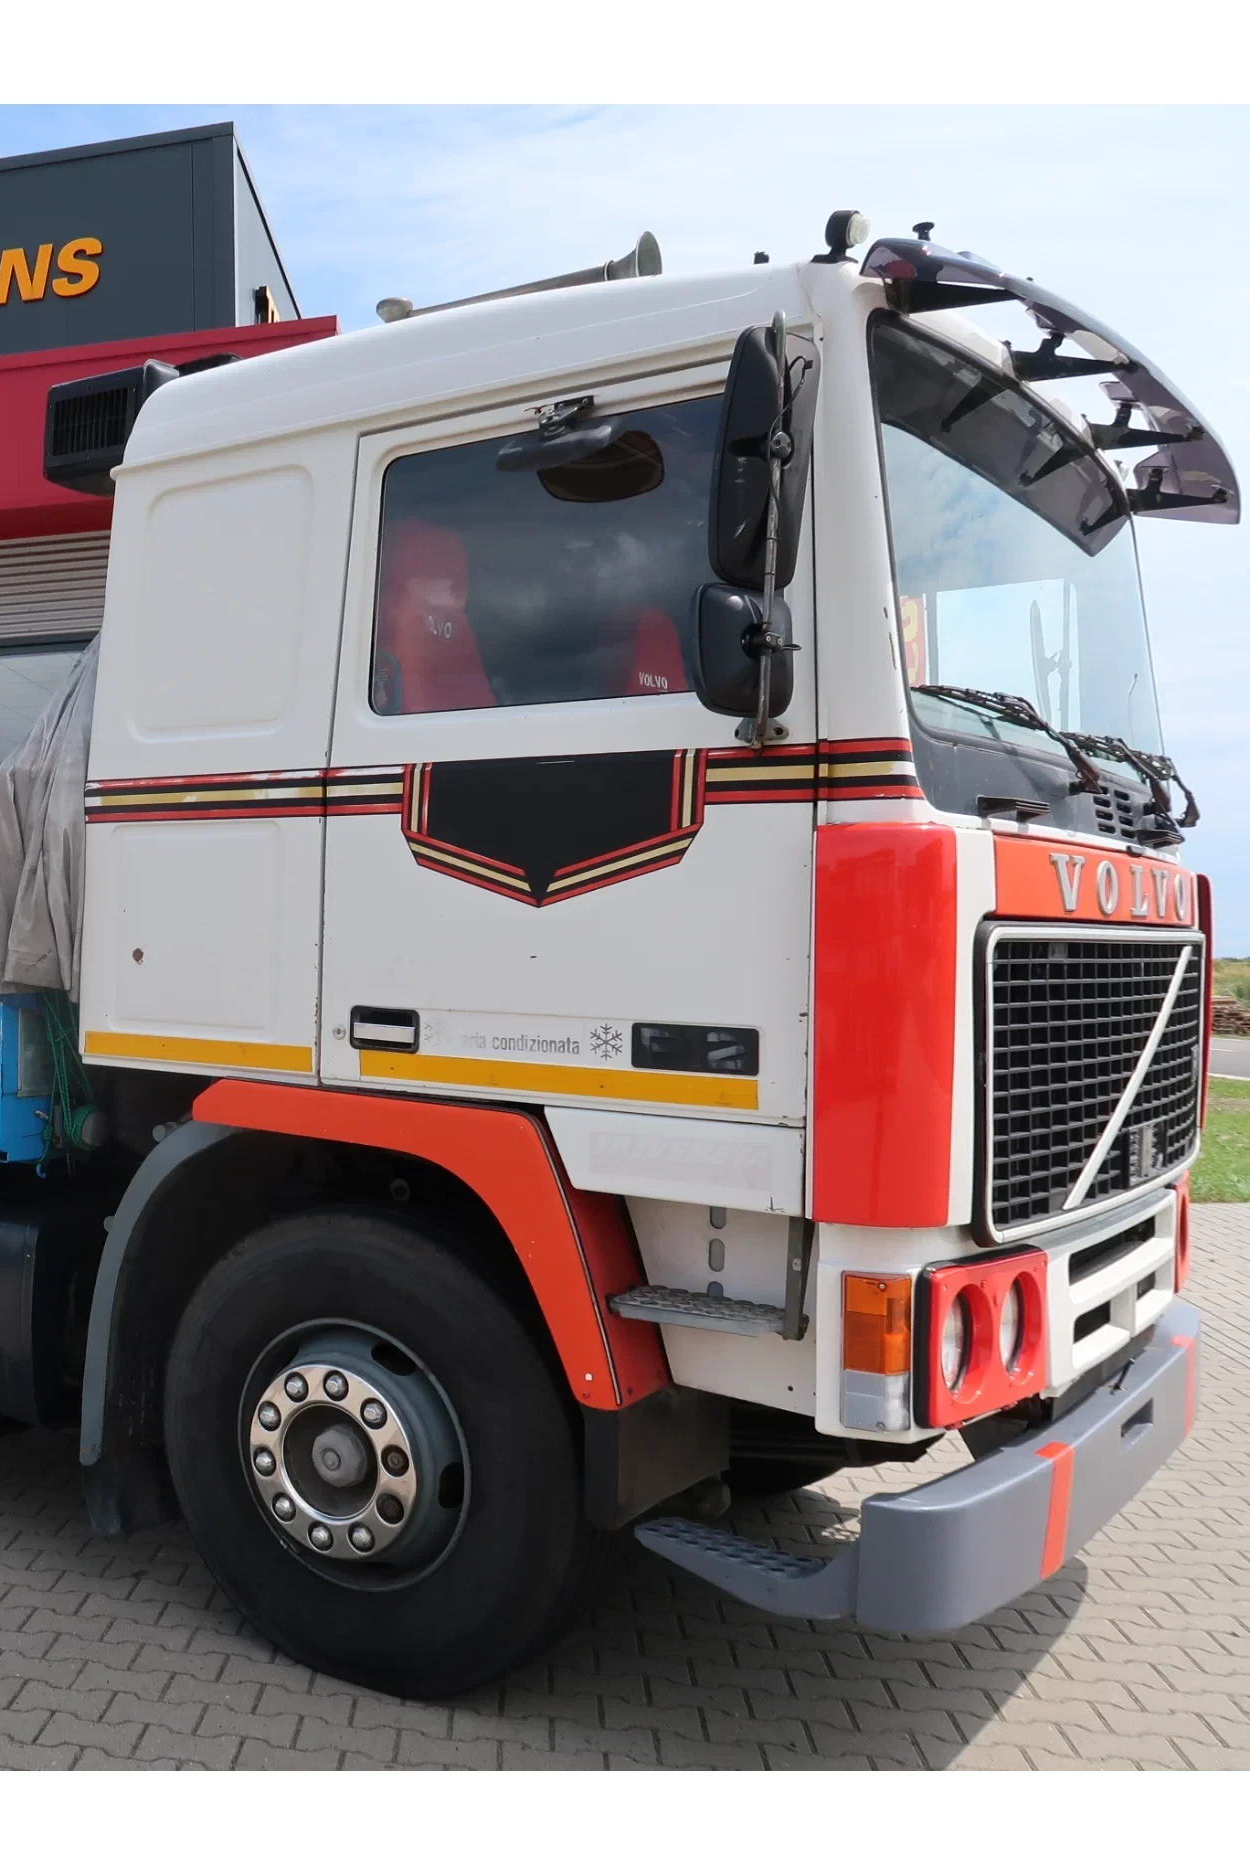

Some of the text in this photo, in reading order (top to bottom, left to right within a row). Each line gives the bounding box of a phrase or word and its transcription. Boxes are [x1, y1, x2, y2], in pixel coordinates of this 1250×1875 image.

[638, 671, 669, 690] VOLVO
[1049, 852, 1188, 921] VOLVO
[491, 1033, 580, 1055] condizionata
